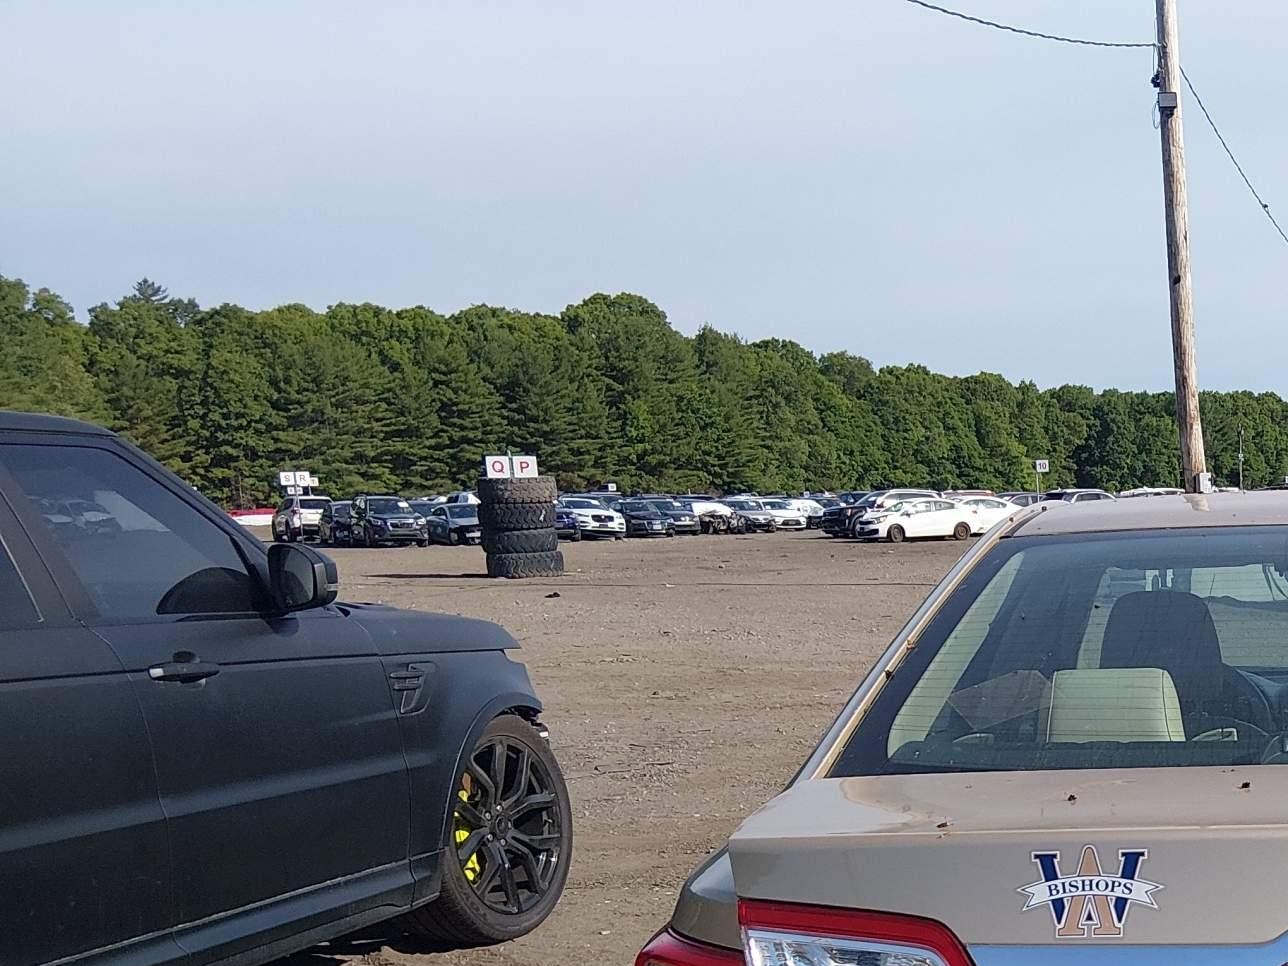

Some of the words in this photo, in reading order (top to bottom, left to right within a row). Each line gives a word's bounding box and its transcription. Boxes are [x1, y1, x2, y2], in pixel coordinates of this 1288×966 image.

[491, 460, 505, 474] Q
[519, 461, 530, 474] P
[1037, 462, 1047, 470] 10
[1047, 879, 1134, 898] BISHOPS
